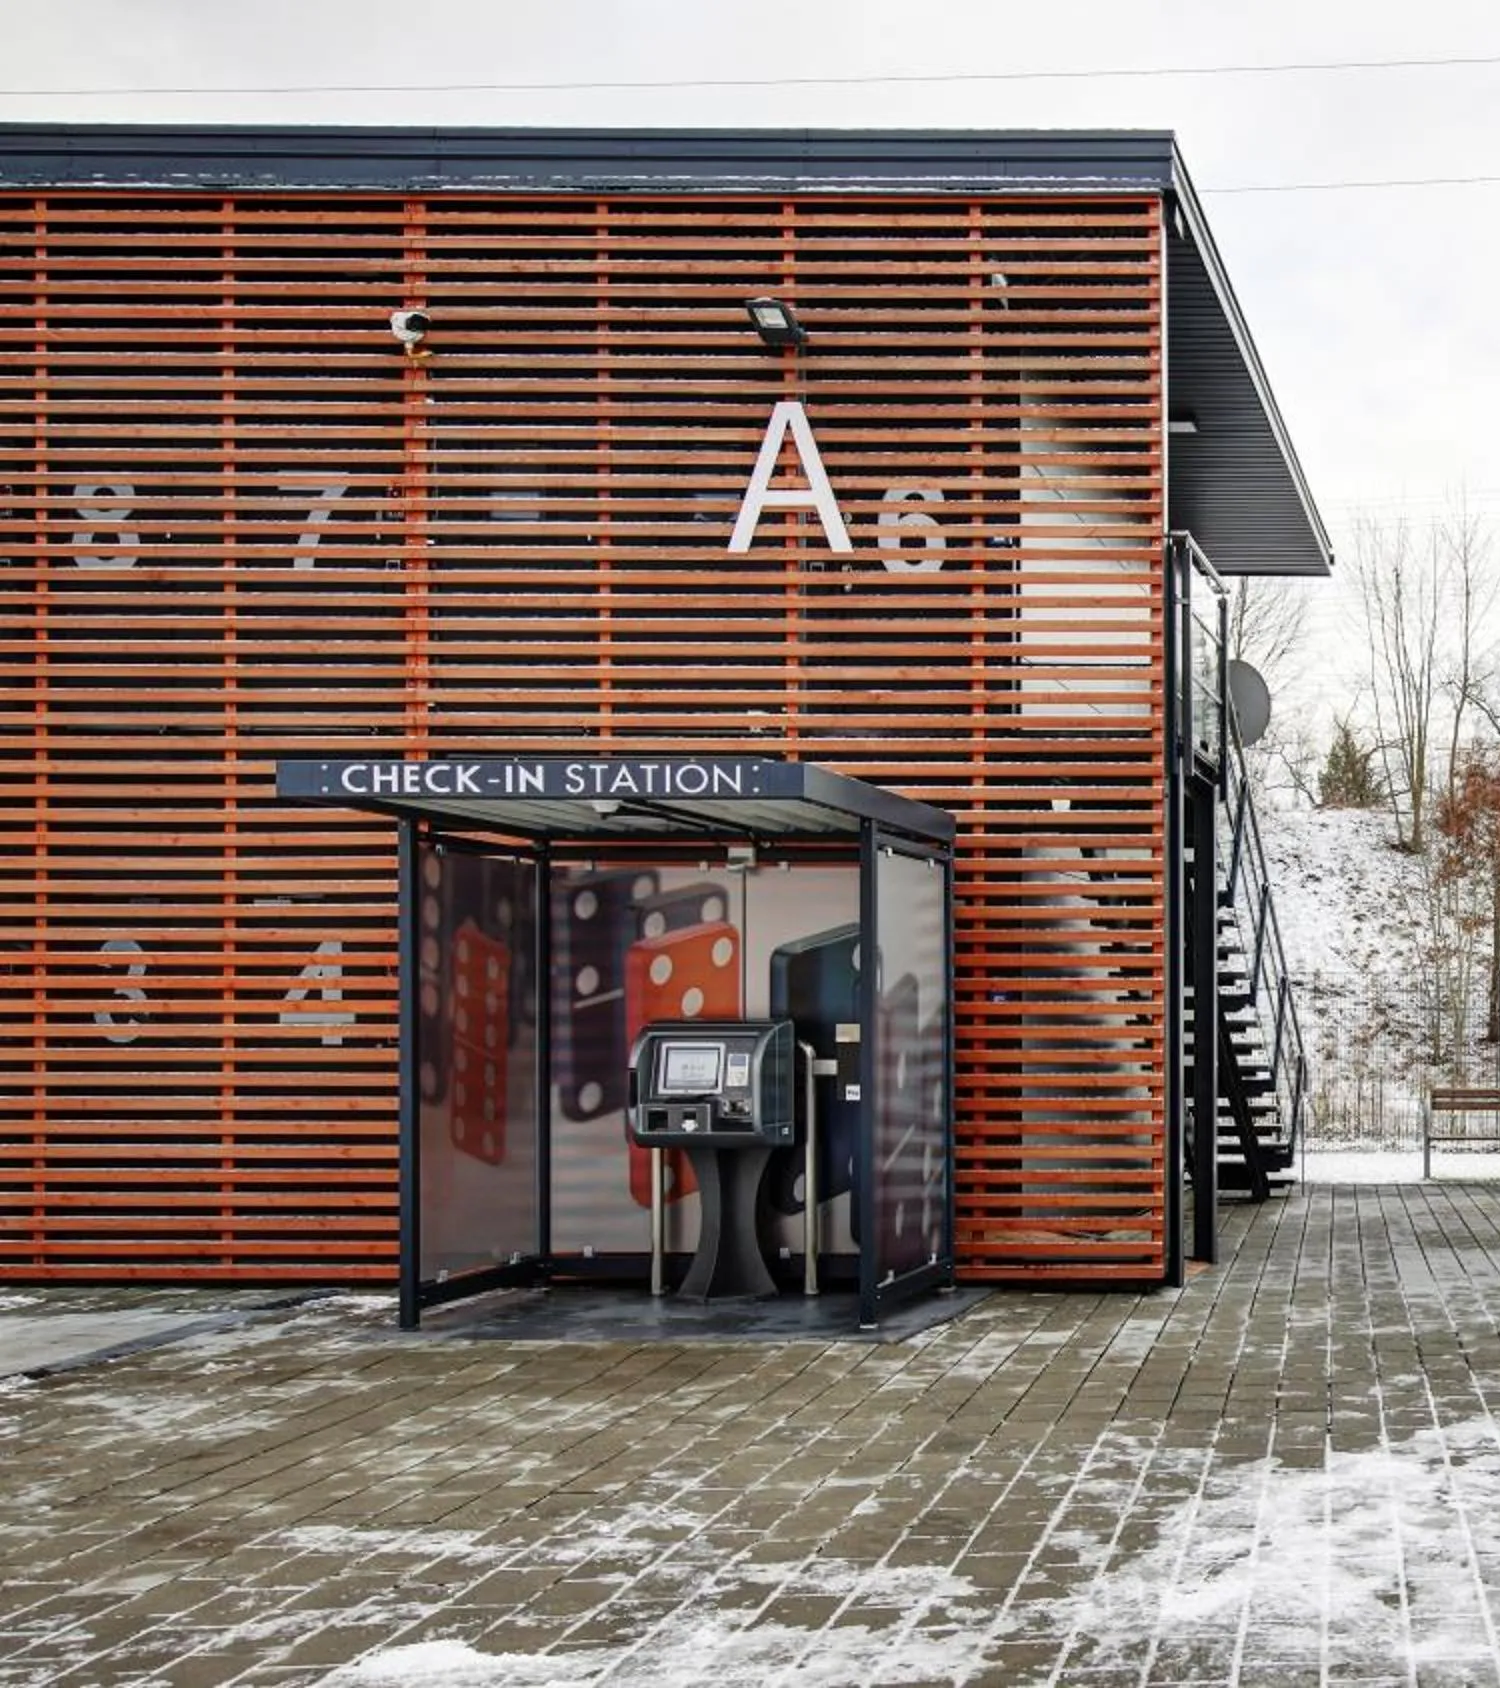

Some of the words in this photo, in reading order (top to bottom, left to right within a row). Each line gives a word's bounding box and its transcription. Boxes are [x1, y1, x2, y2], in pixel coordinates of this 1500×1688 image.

[71, 473, 141, 573] 8
[278, 470, 349, 570] 7
[727, 402, 854, 553] A
[877, 478, 947, 575] 6
[341, 763, 544, 795] CHECK-IN
[279, 939, 356, 1045] 4
